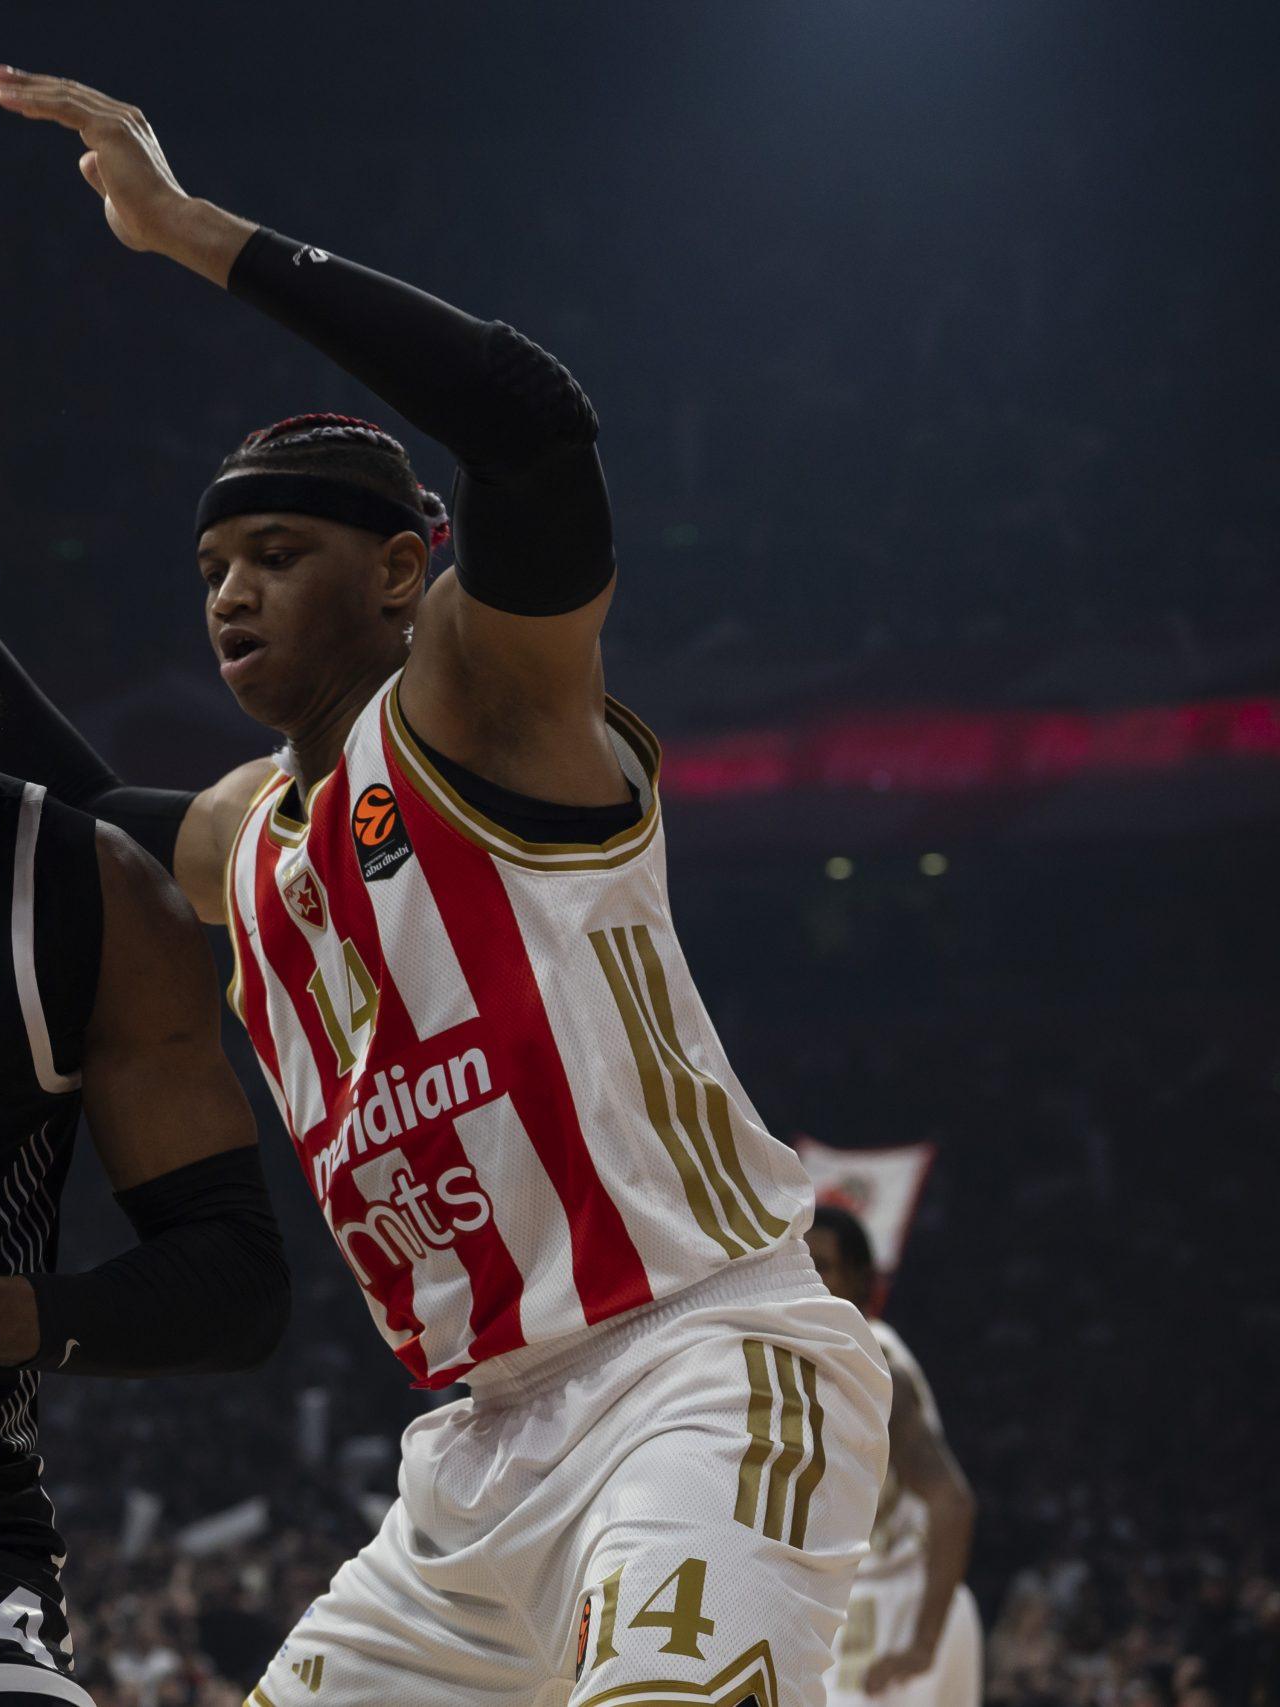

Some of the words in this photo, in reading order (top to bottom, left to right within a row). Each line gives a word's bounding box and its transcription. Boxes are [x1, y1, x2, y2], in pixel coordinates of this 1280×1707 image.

[365, 860, 383, 877] abu
[382, 843, 410, 867] dhabi
[306, 937, 381, 1077] 14
[336, 1166, 491, 1287] mts
[590, 1557, 716, 1671] 14
